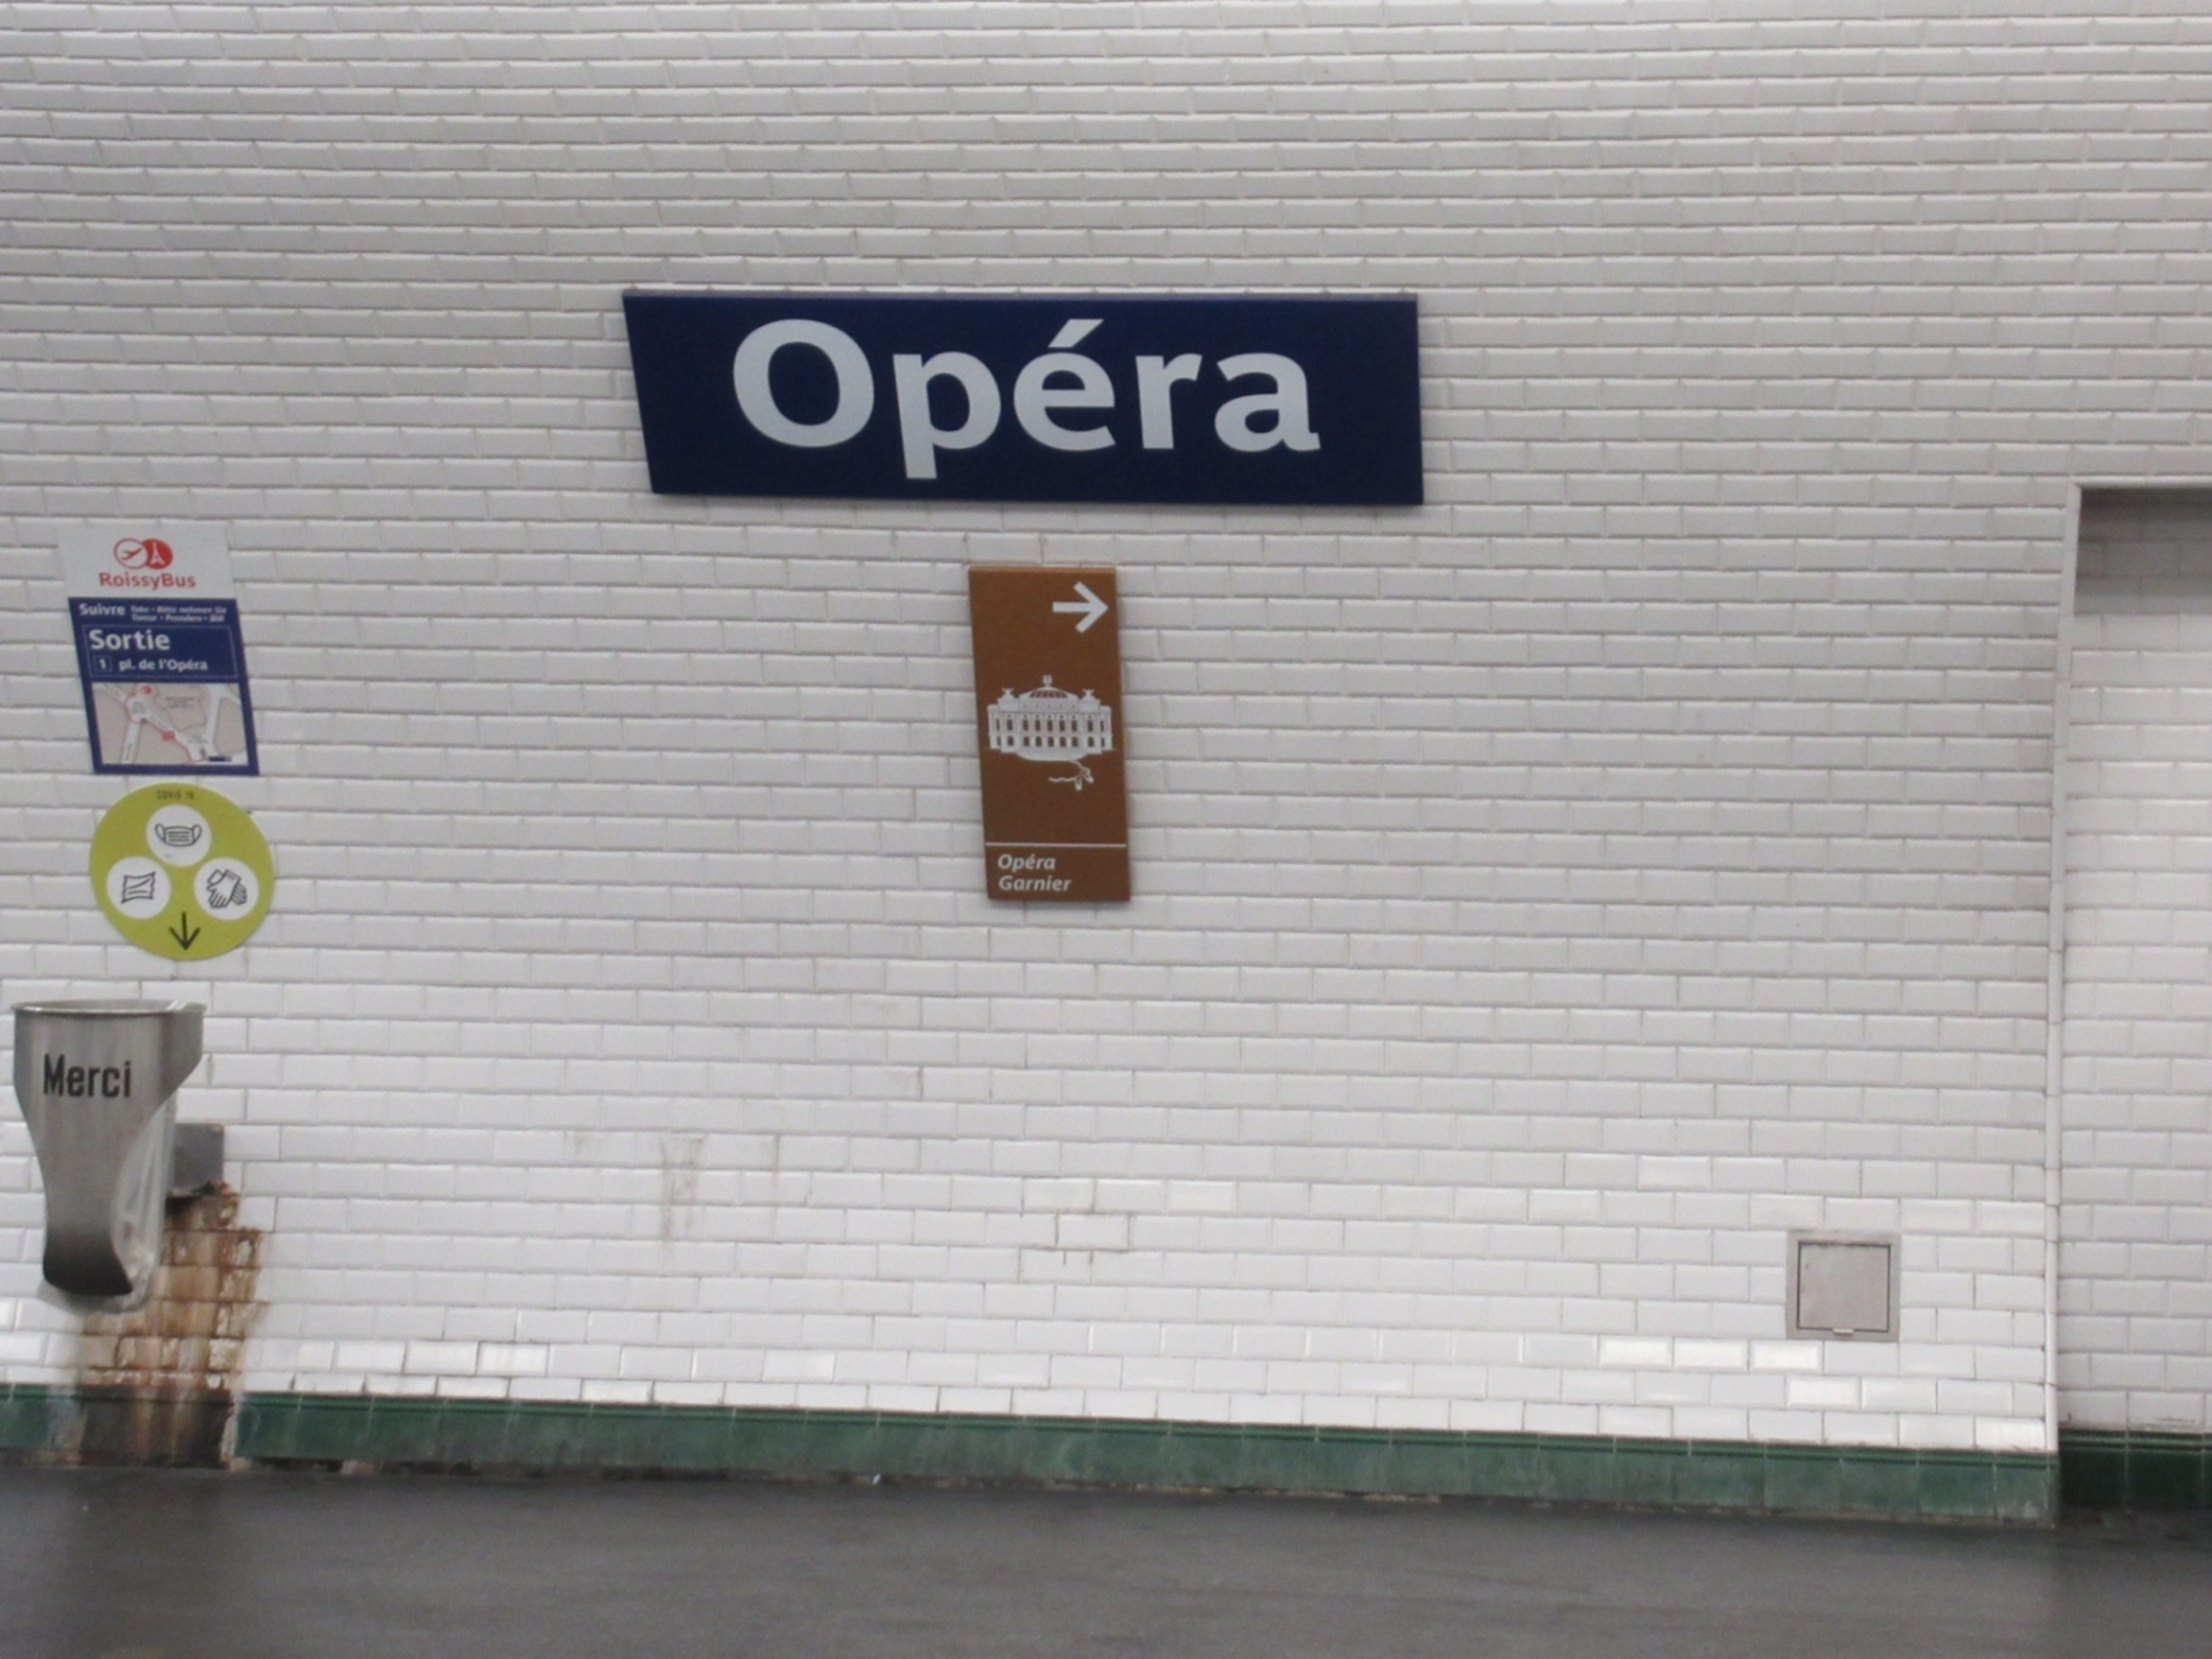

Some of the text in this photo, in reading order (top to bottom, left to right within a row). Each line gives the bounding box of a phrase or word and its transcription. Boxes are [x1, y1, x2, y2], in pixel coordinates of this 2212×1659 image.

[733, 318, 1321, 479] Opéra
[99, 571, 197, 591] RoissyBus
[79, 603, 126, 616] Suivre
[89, 629, 171, 650] Sortie
[99, 658, 106, 669] 1
[119, 659, 136, 672] pl.
[138, 658, 156, 670] de
[998, 853, 1056, 873] Opéra
[998, 875, 1072, 891] Garnier
[43, 1053, 131, 1099] Merci
